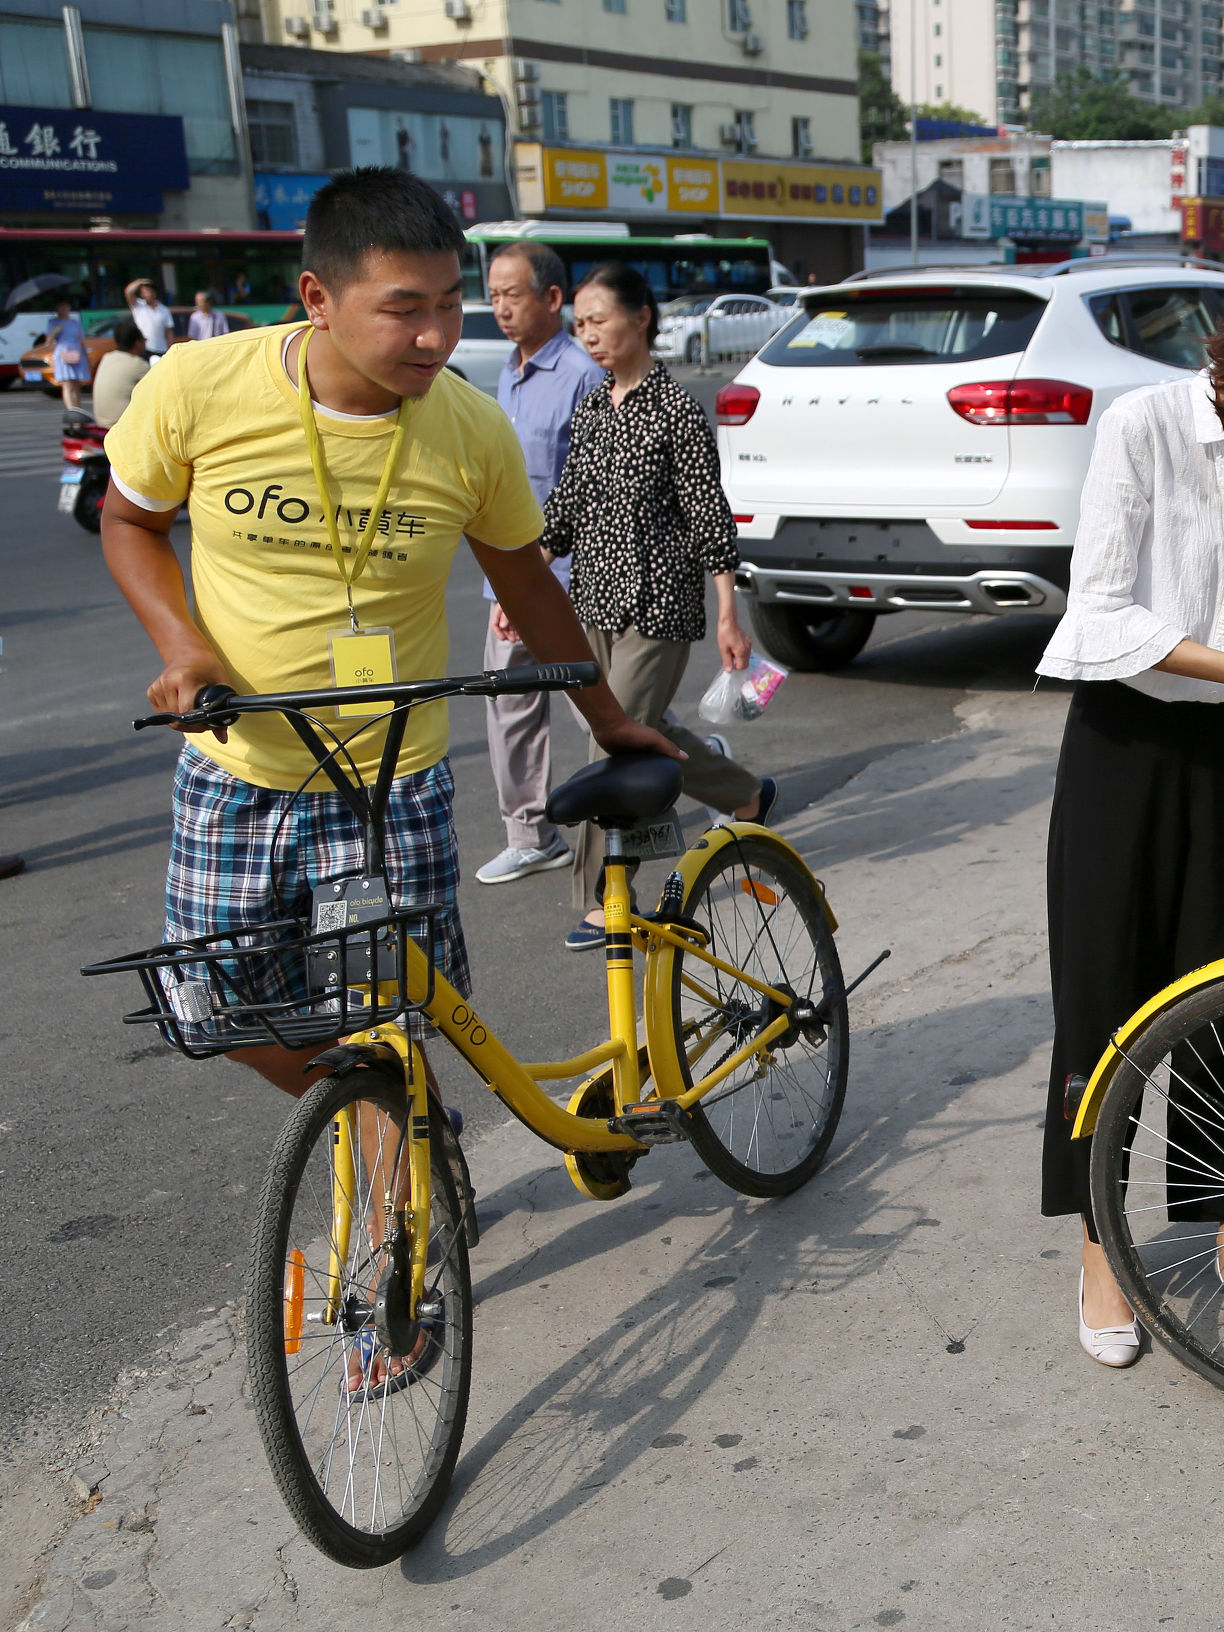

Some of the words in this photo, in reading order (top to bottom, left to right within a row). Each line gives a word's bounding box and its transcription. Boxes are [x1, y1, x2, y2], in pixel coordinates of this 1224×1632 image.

[224, 485, 310, 524] ofo
[354, 667, 374, 677] ofo
[350, 899, 361, 907] ofo
[451, 1003, 487, 1047] ofo
